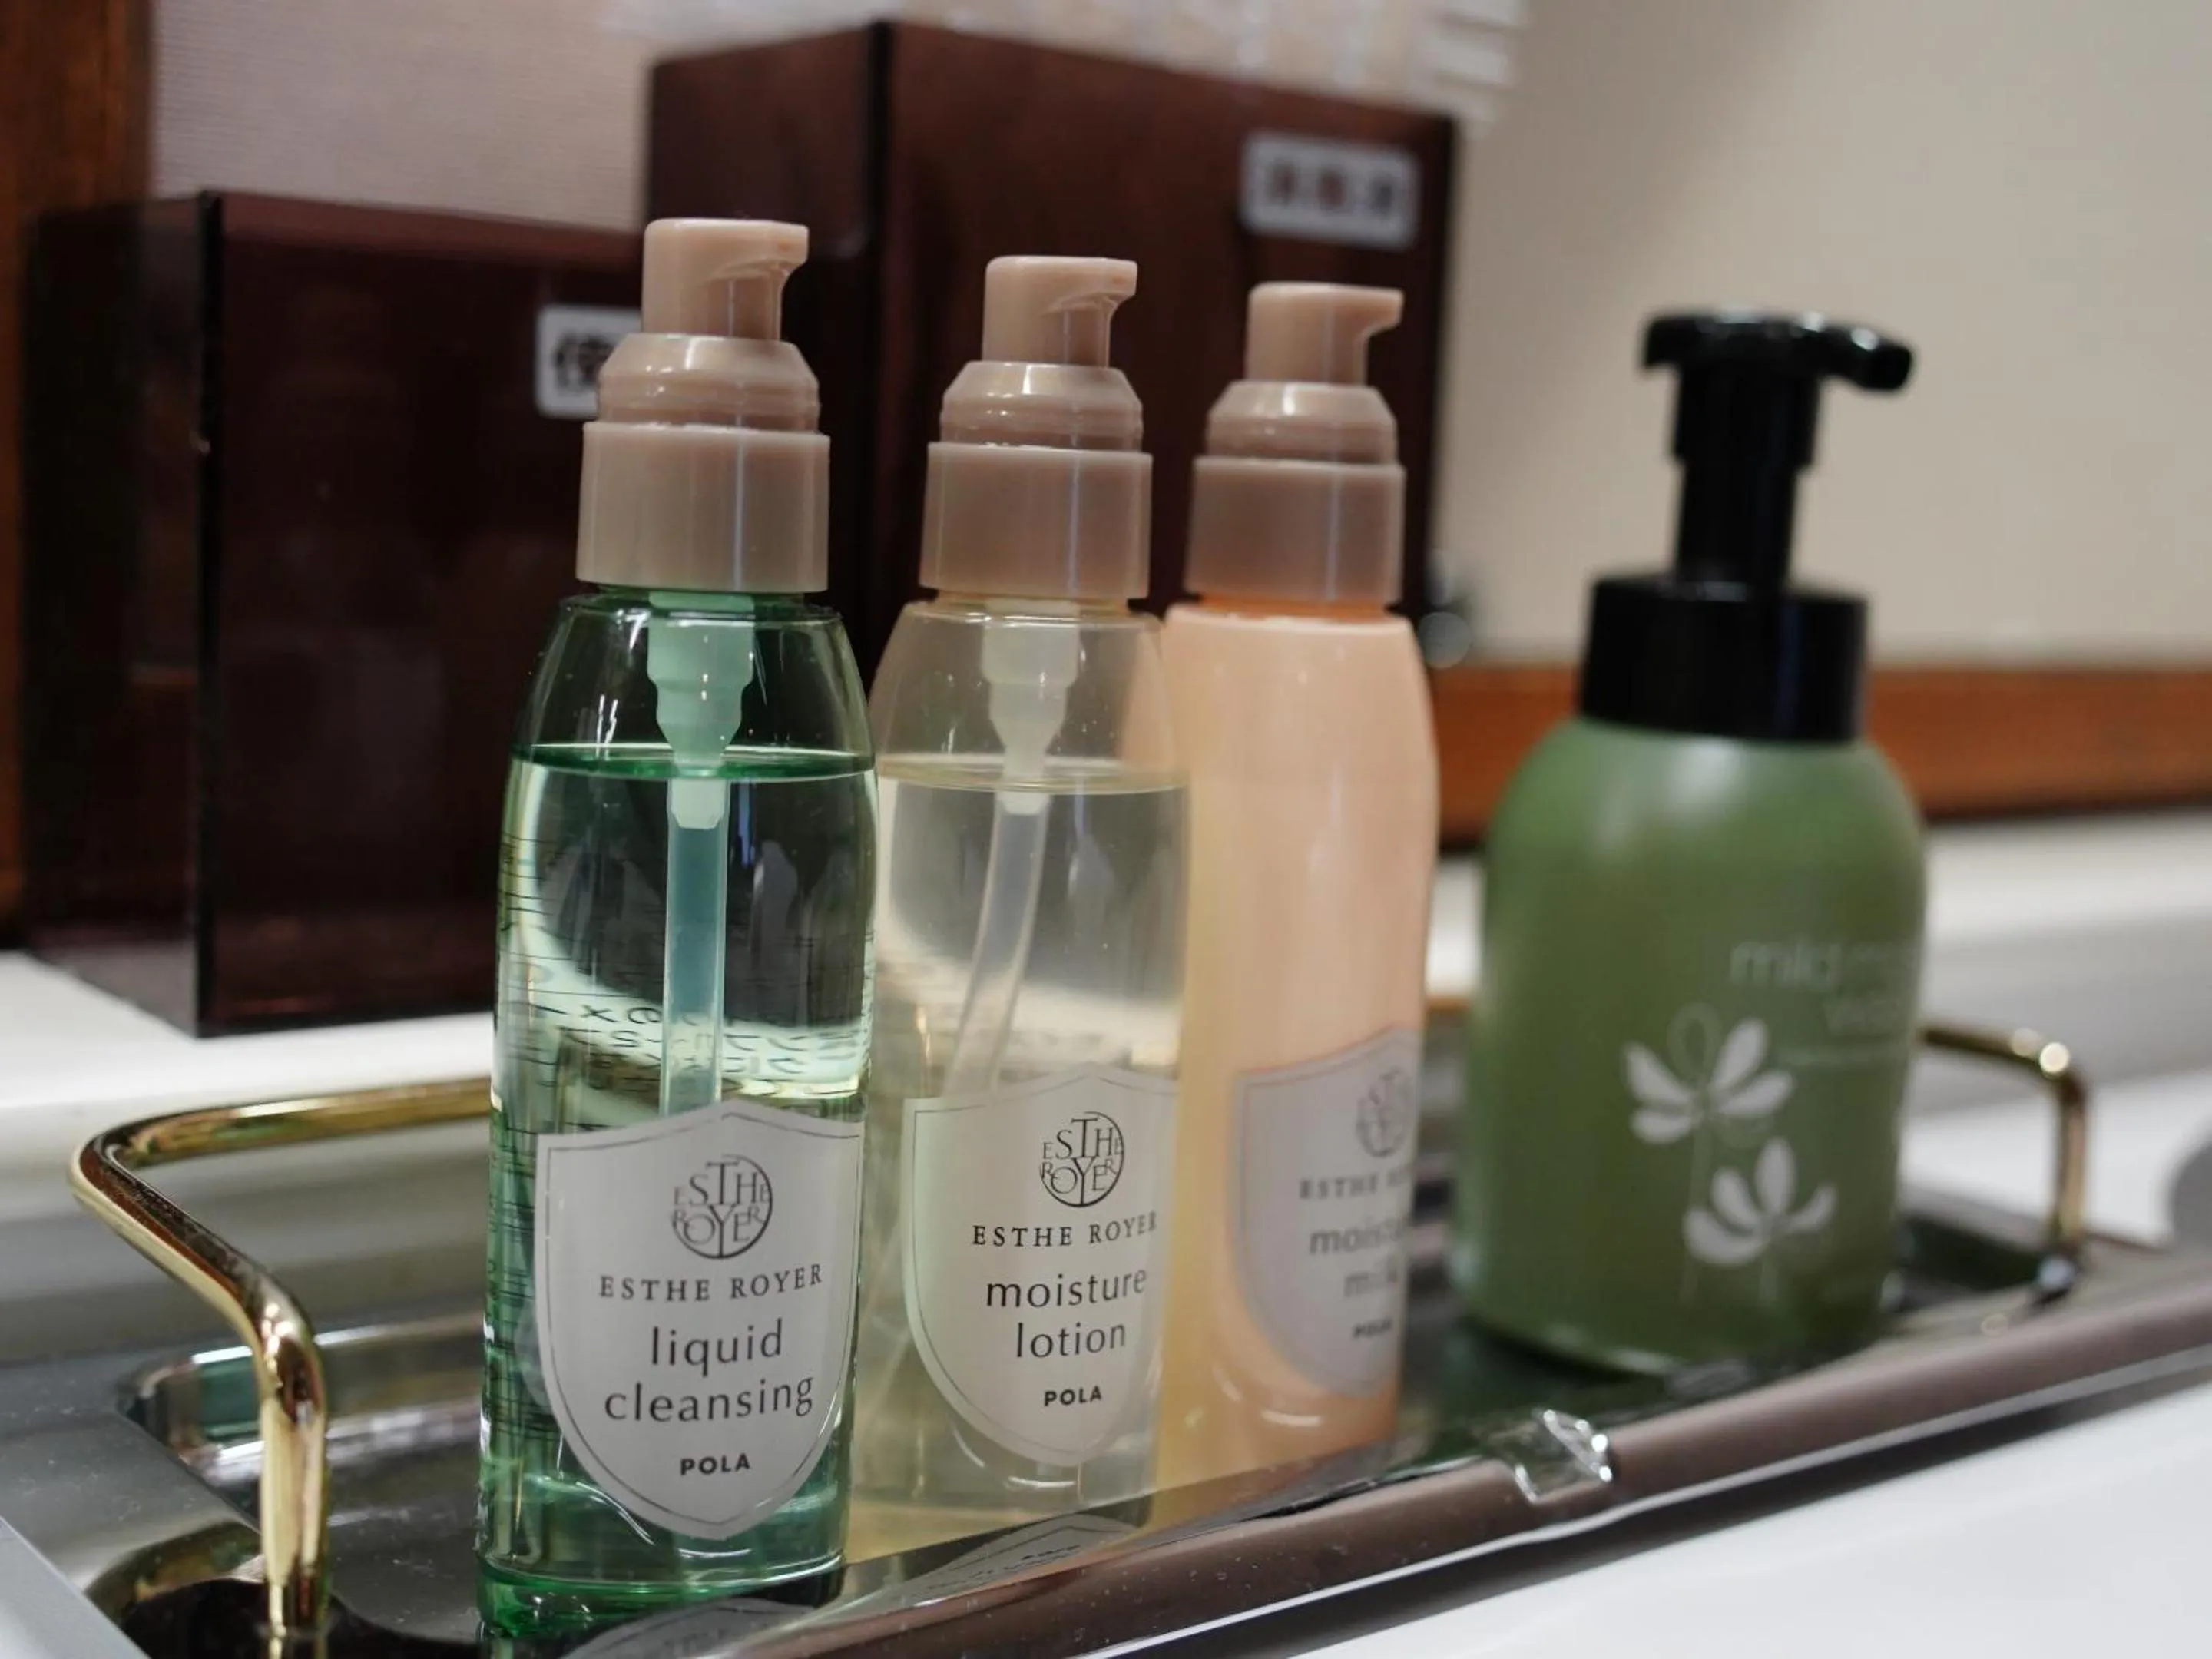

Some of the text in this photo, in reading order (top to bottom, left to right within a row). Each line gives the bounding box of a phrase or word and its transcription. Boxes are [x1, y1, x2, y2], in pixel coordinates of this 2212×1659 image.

[972, 1210, 1157, 1247] ESTHE ROYER
[600, 1264, 823, 1302] ESTHE ROYER
[985, 1269, 1147, 1308] moisture
[651, 1318, 783, 1378] liquid
[1015, 1322, 1127, 1358] lotion
[604, 1376, 815, 1422] cleansing
[1043, 1385, 1103, 1407] POLA
[680, 1452, 751, 1476] POLA
